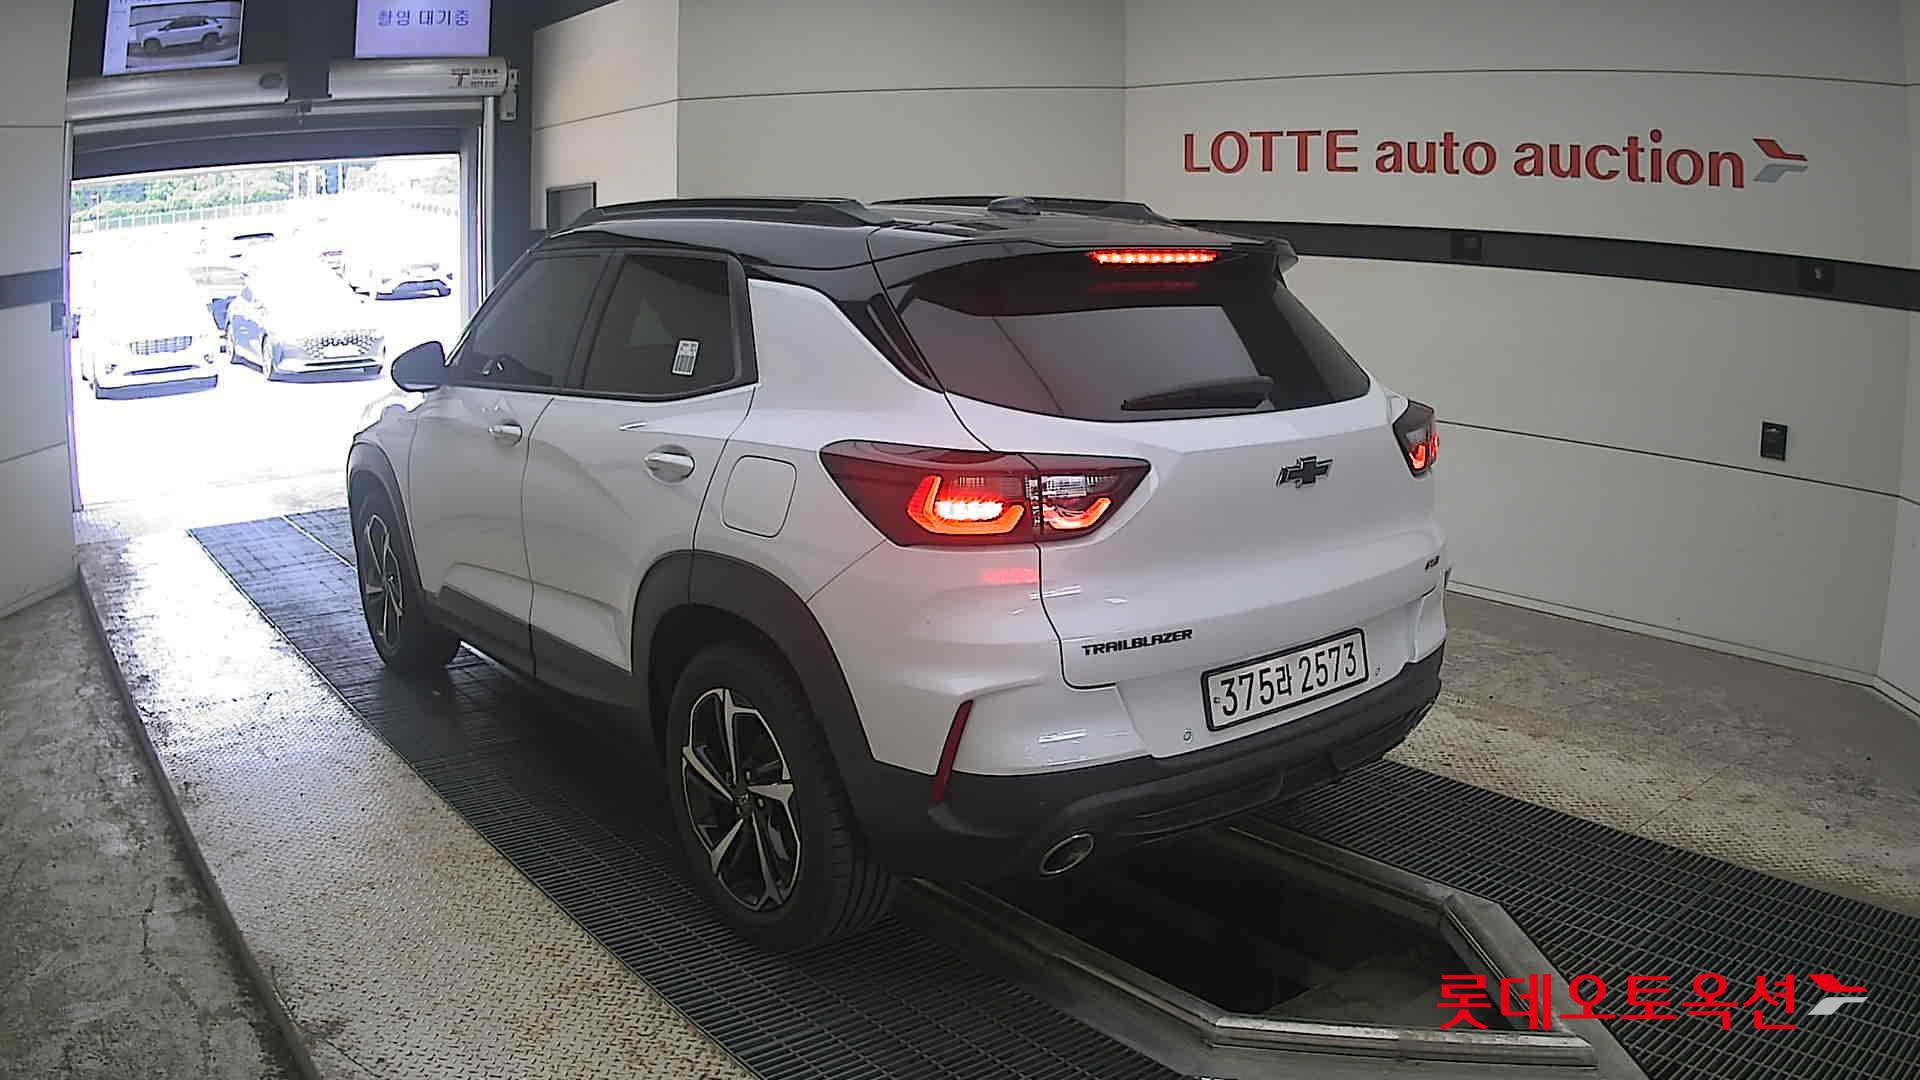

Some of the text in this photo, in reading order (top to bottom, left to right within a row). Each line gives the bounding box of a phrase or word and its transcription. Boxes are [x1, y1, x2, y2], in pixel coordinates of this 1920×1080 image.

[419, 9, 469, 26] 대기중
[1184, 129, 1744, 188] LOTTE auto auction
[1081, 629, 1193, 656] TRAILBLAZER
[1220, 641, 1357, 716] 375라 2573
